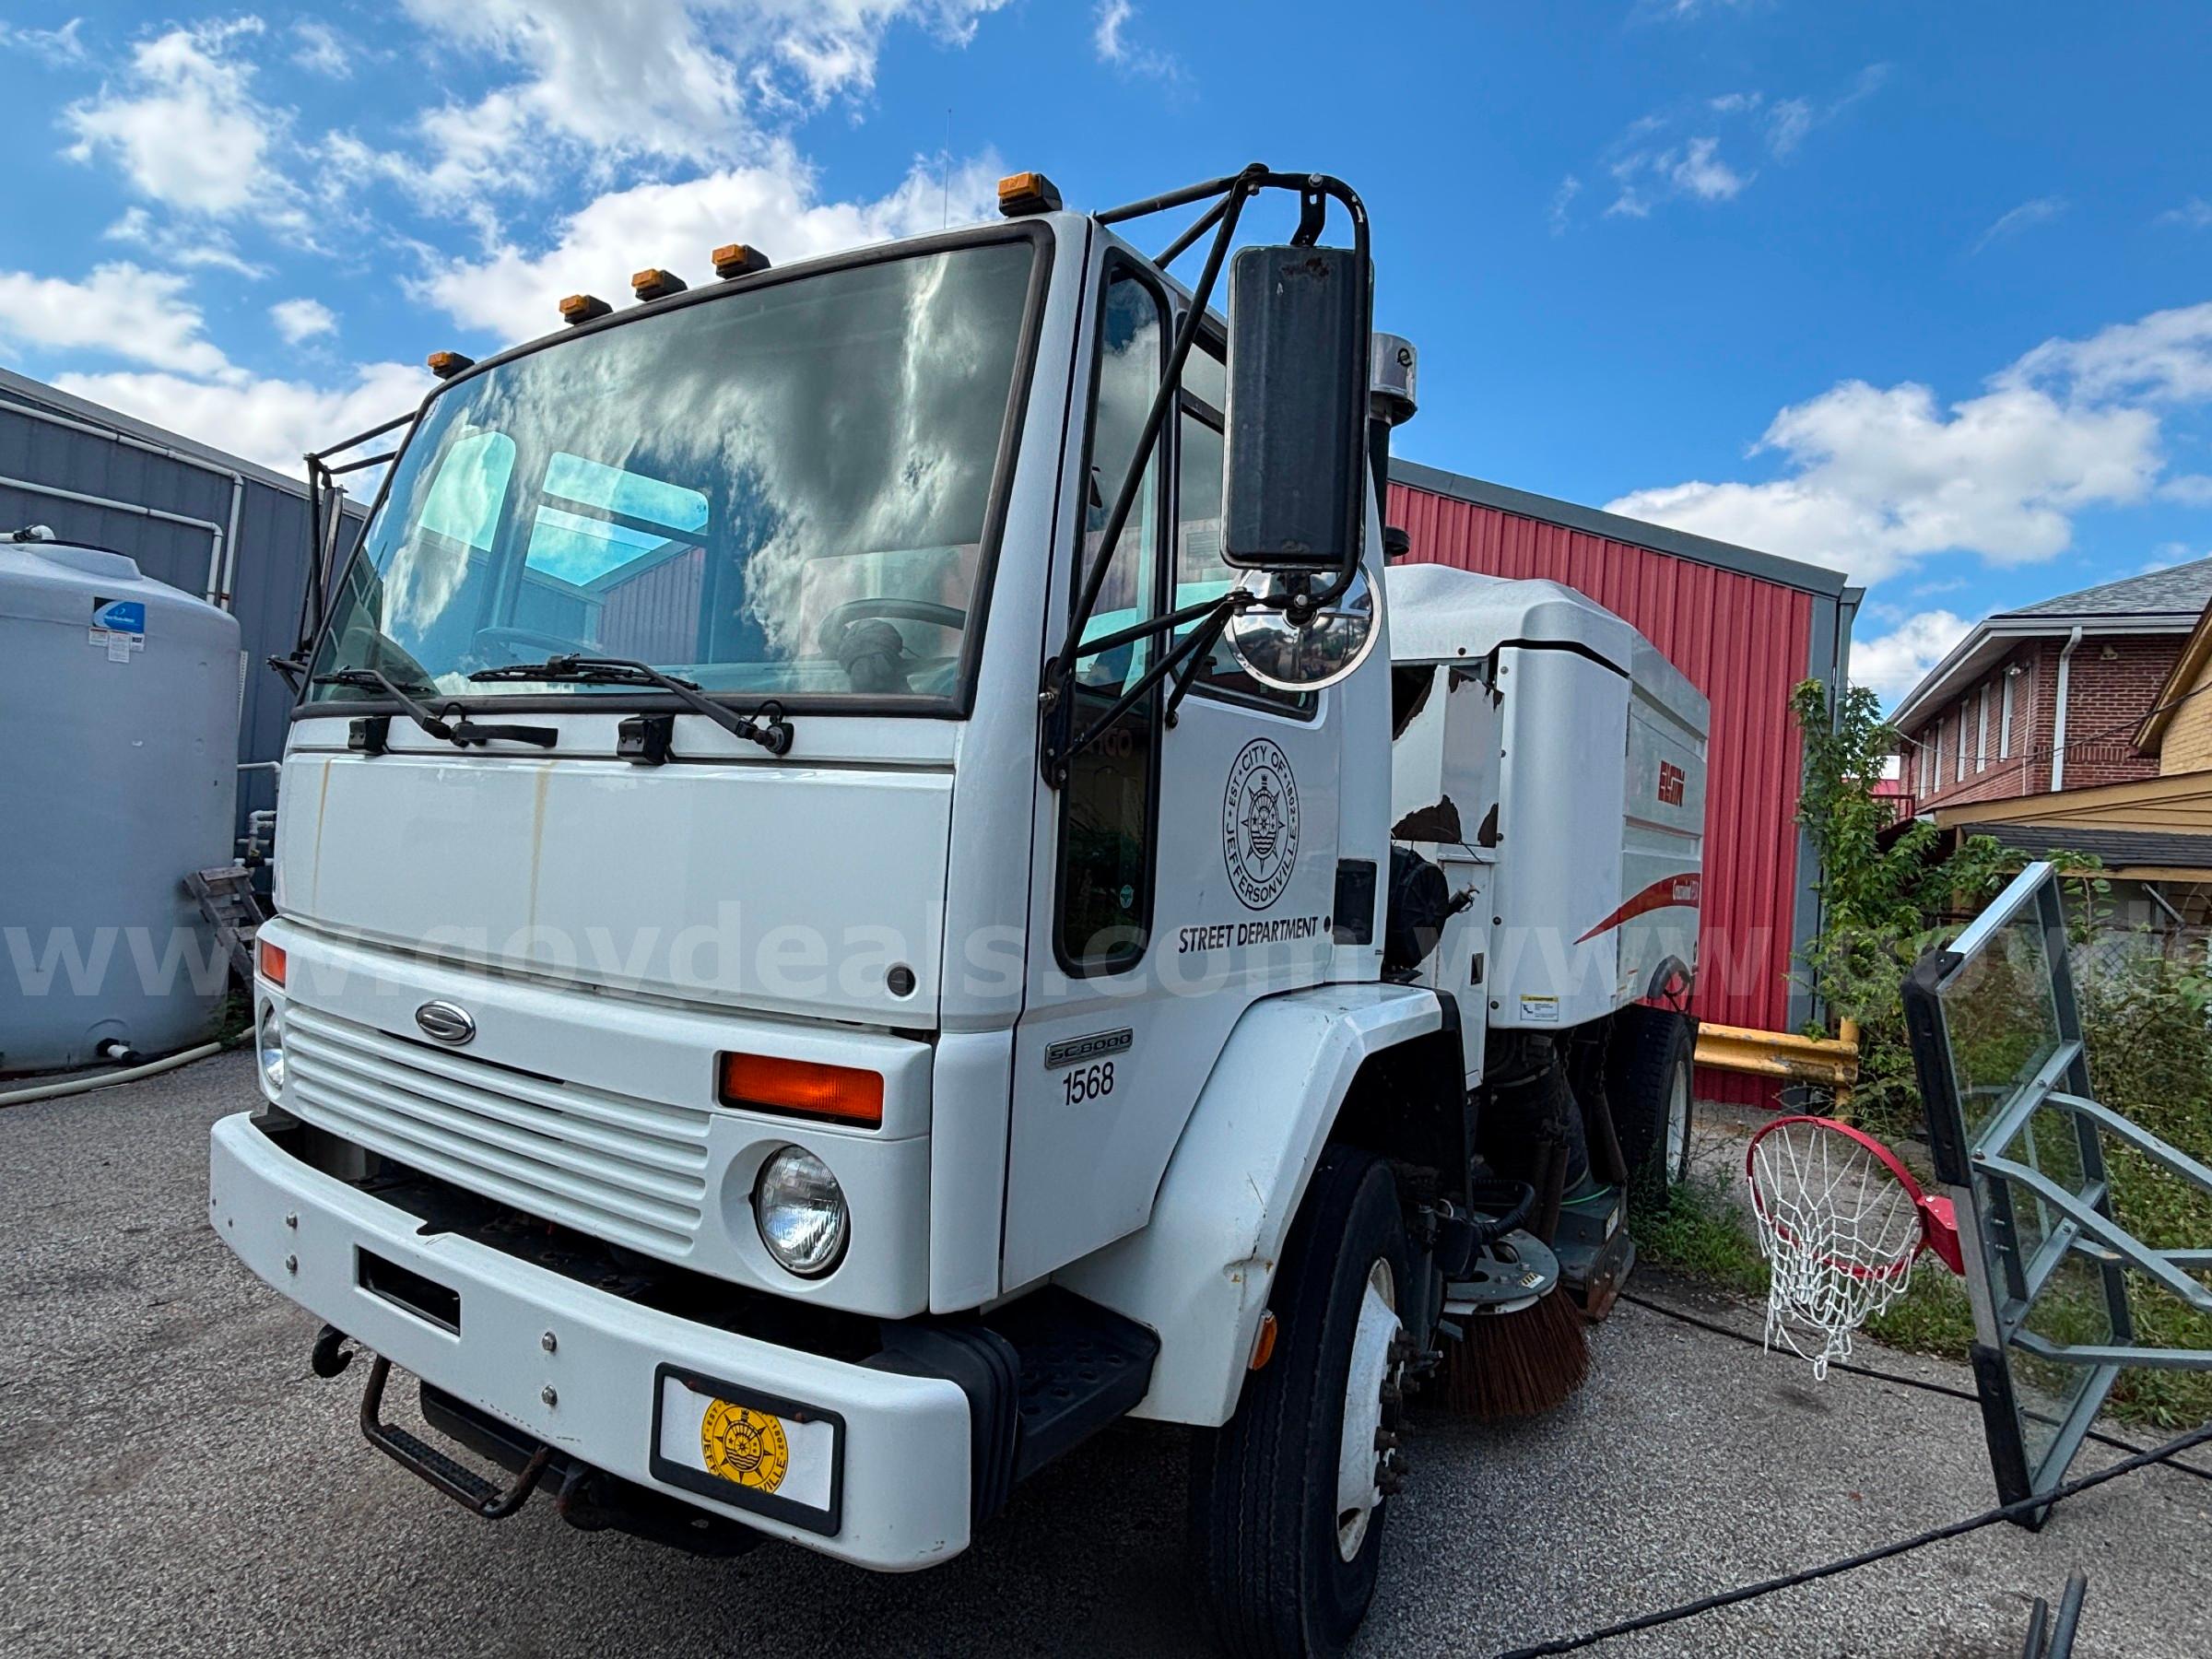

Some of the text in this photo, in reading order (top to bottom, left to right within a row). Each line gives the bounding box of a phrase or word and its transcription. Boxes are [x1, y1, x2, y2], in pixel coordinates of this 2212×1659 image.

[1241, 745, 1287, 773] CITY OF
[1229, 776, 1241, 807] EST
[1285, 781, 1296, 815] 1802
[1226, 822, 1298, 902] JEFFERSONVILLE
[1179, 916, 1319, 953] STREET DEPARTMENT
[1063, 1061, 1114, 1106] 1568
[706, 1407, 718, 1426] EST
[771, 1424, 784, 1451] 1802
